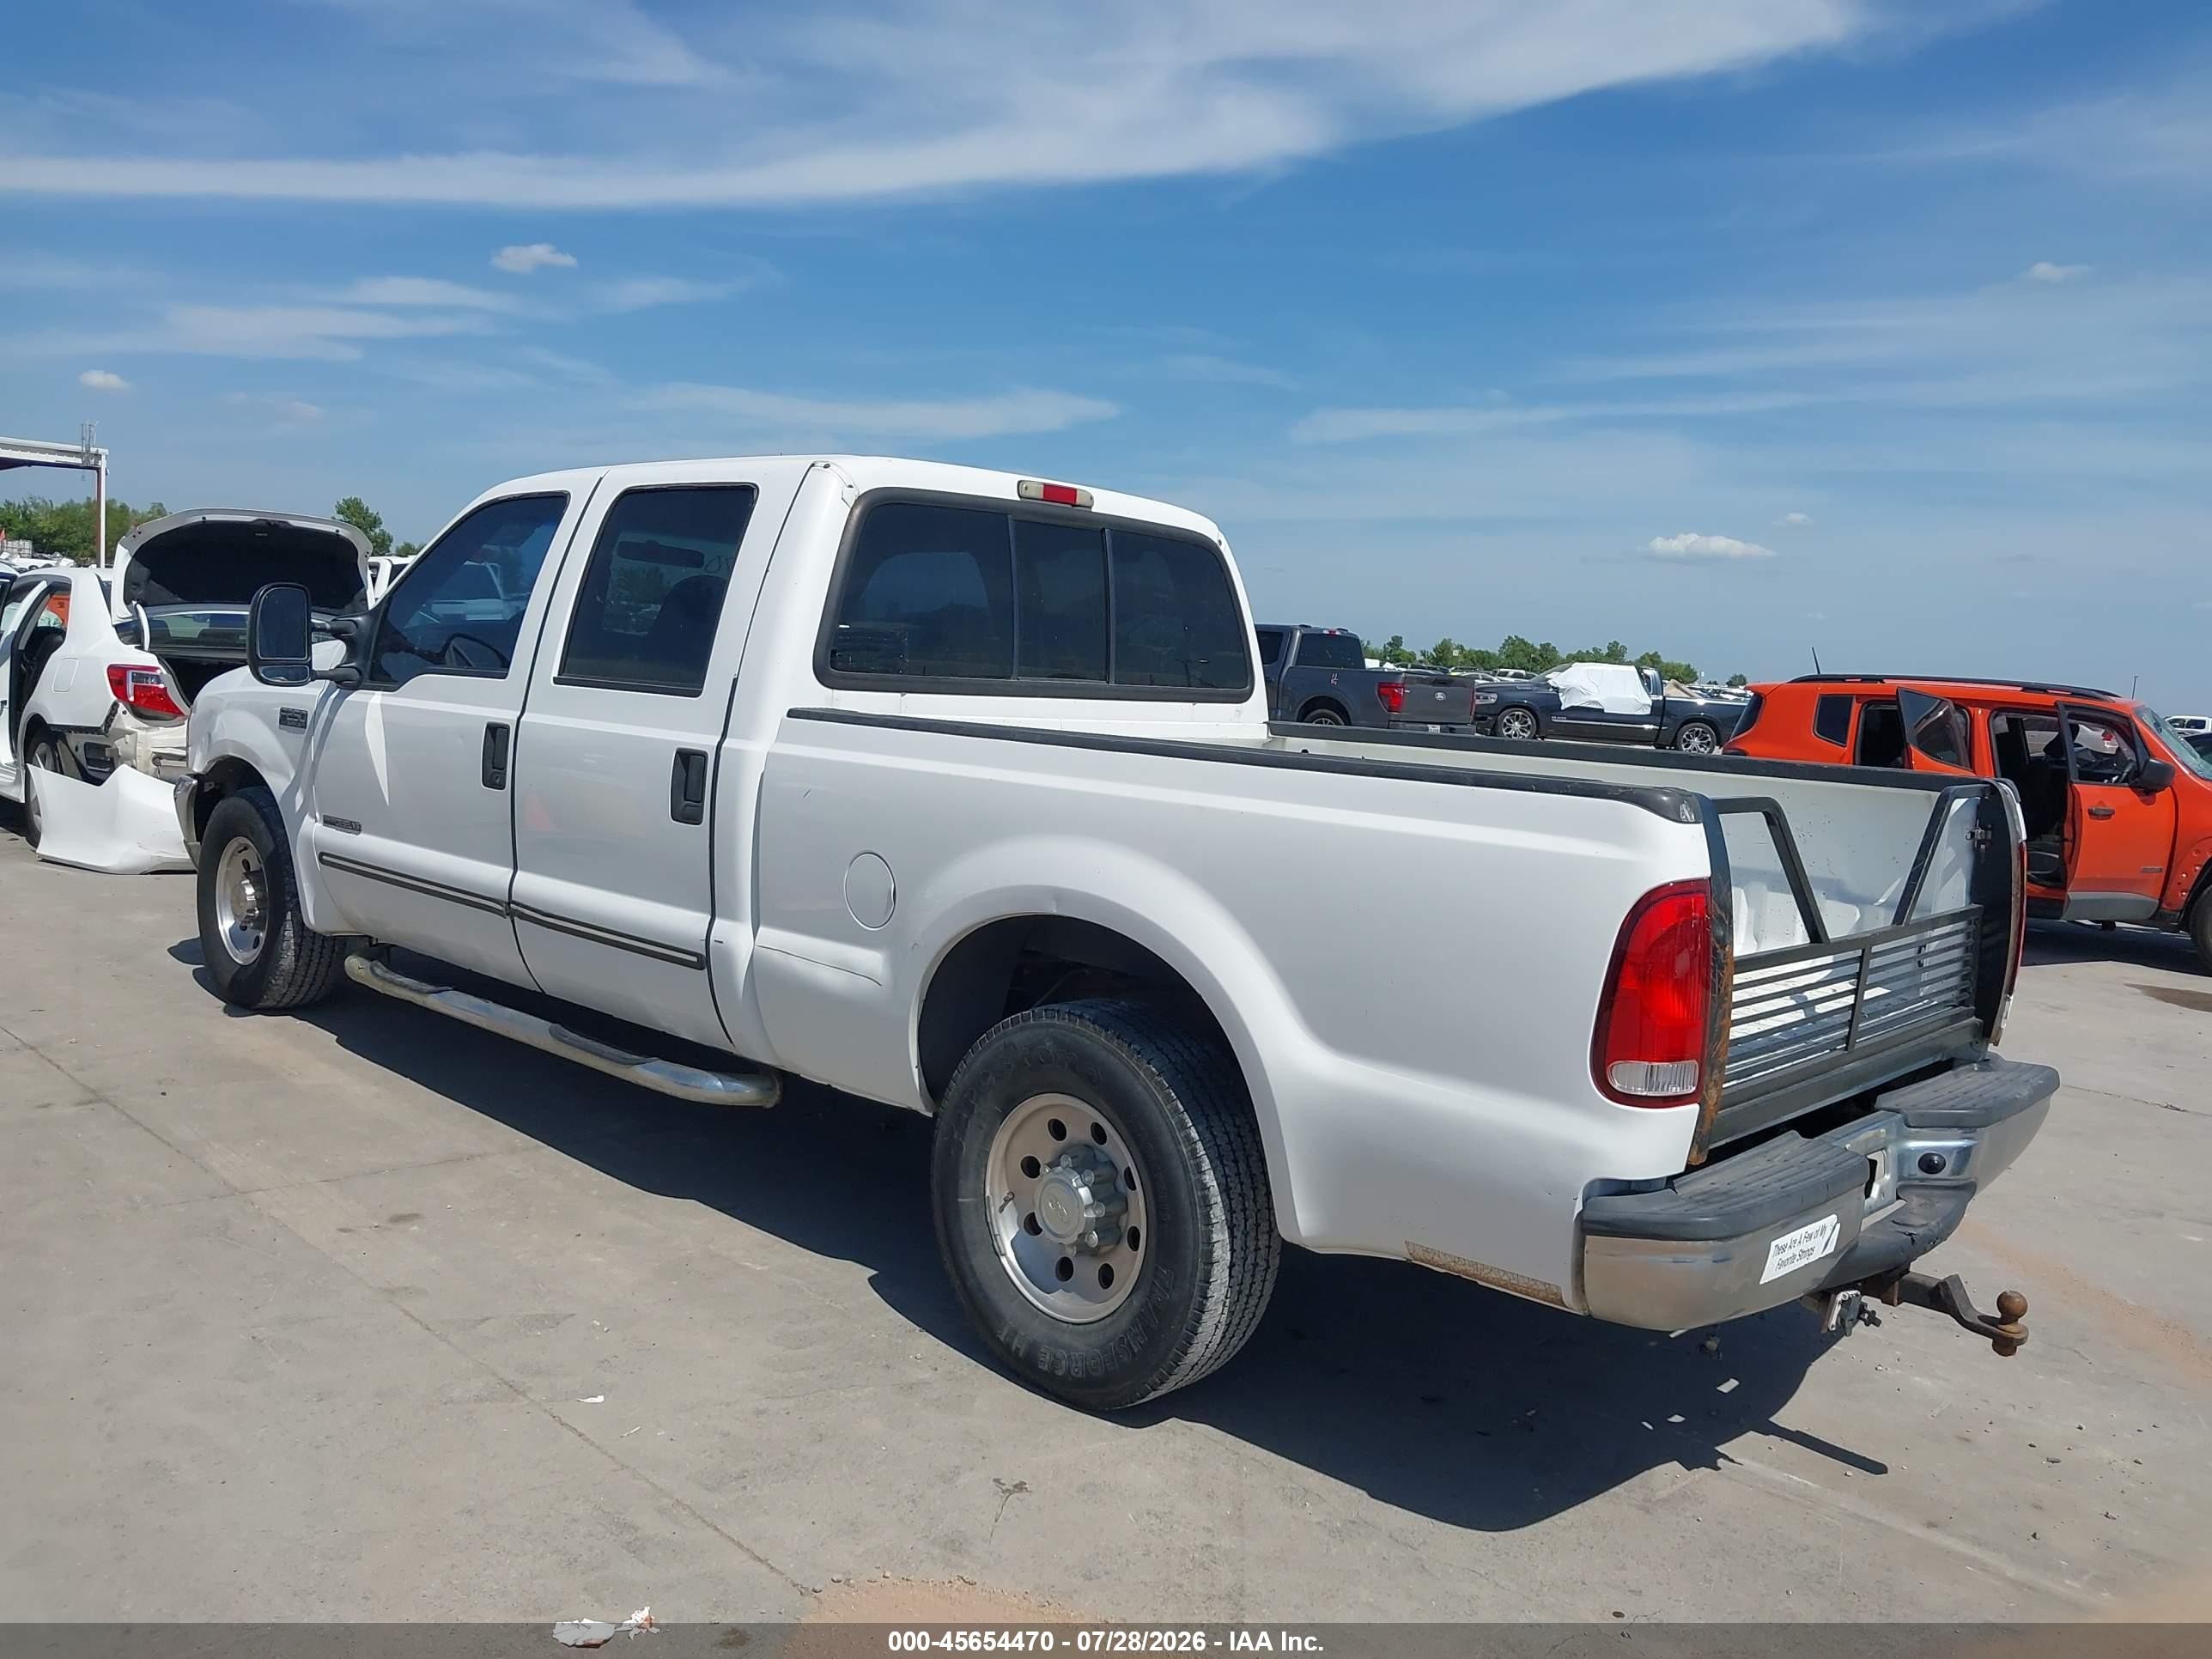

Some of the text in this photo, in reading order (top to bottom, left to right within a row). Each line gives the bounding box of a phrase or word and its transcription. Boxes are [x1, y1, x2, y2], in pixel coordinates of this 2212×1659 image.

[1772, 1243, 1788, 1257] These
[1788, 1237, 1797, 1250] Are
[1802, 1231, 1814, 1245] Few
[1775, 1246, 1815, 1271] Favorite Strings
[1037, 1264, 1175, 1378] TRANSFORCE
